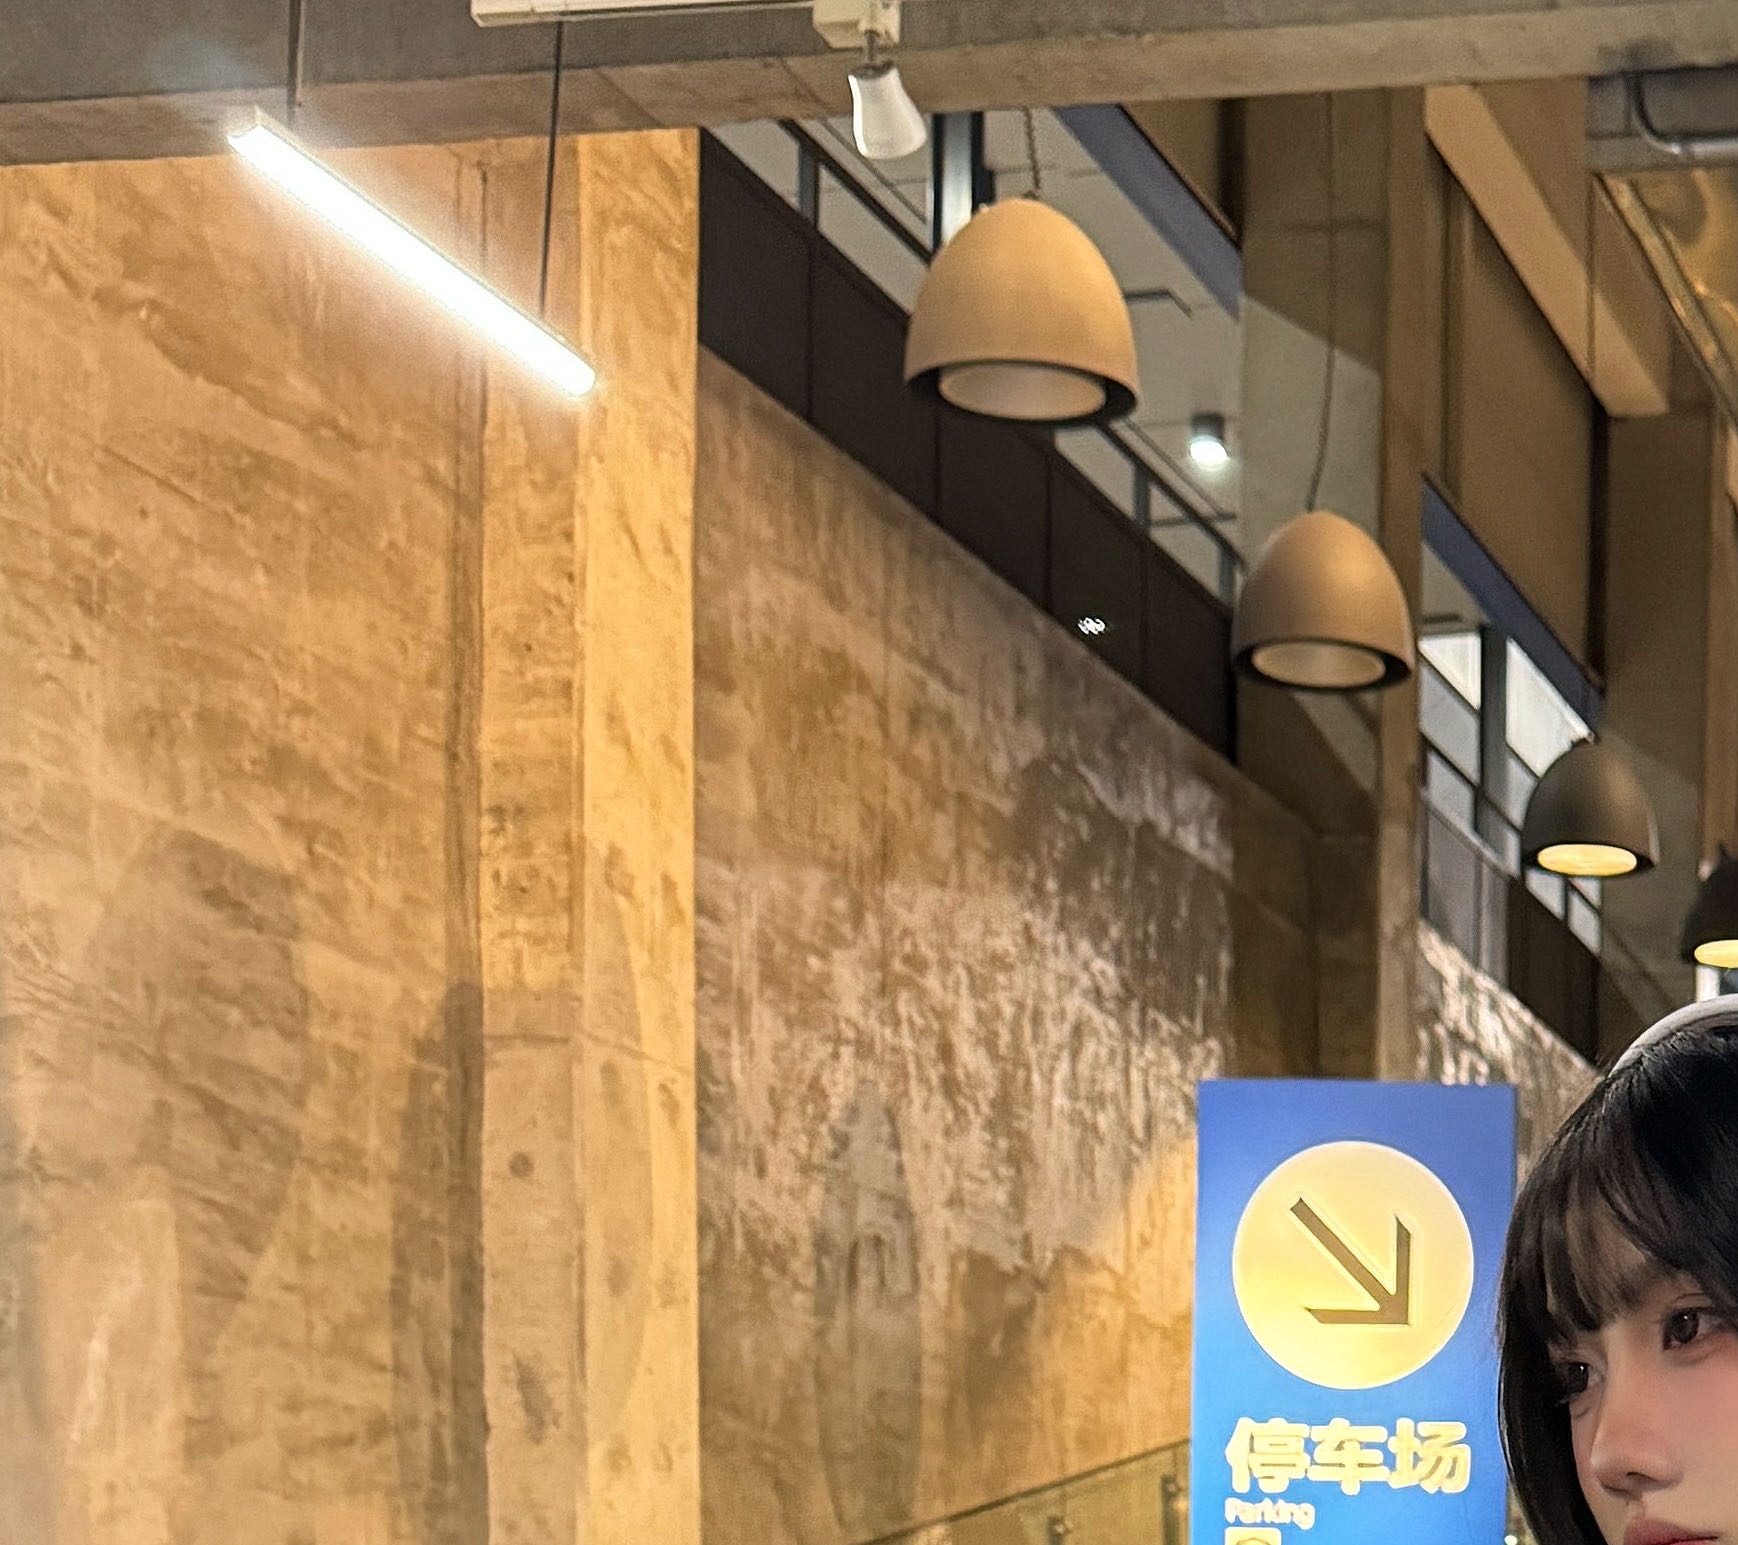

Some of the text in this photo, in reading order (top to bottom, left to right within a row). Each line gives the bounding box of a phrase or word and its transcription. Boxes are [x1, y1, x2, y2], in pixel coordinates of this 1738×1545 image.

[1225, 1417, 1471, 1495] 停车场
[1225, 1498, 1315, 1530] Parking
